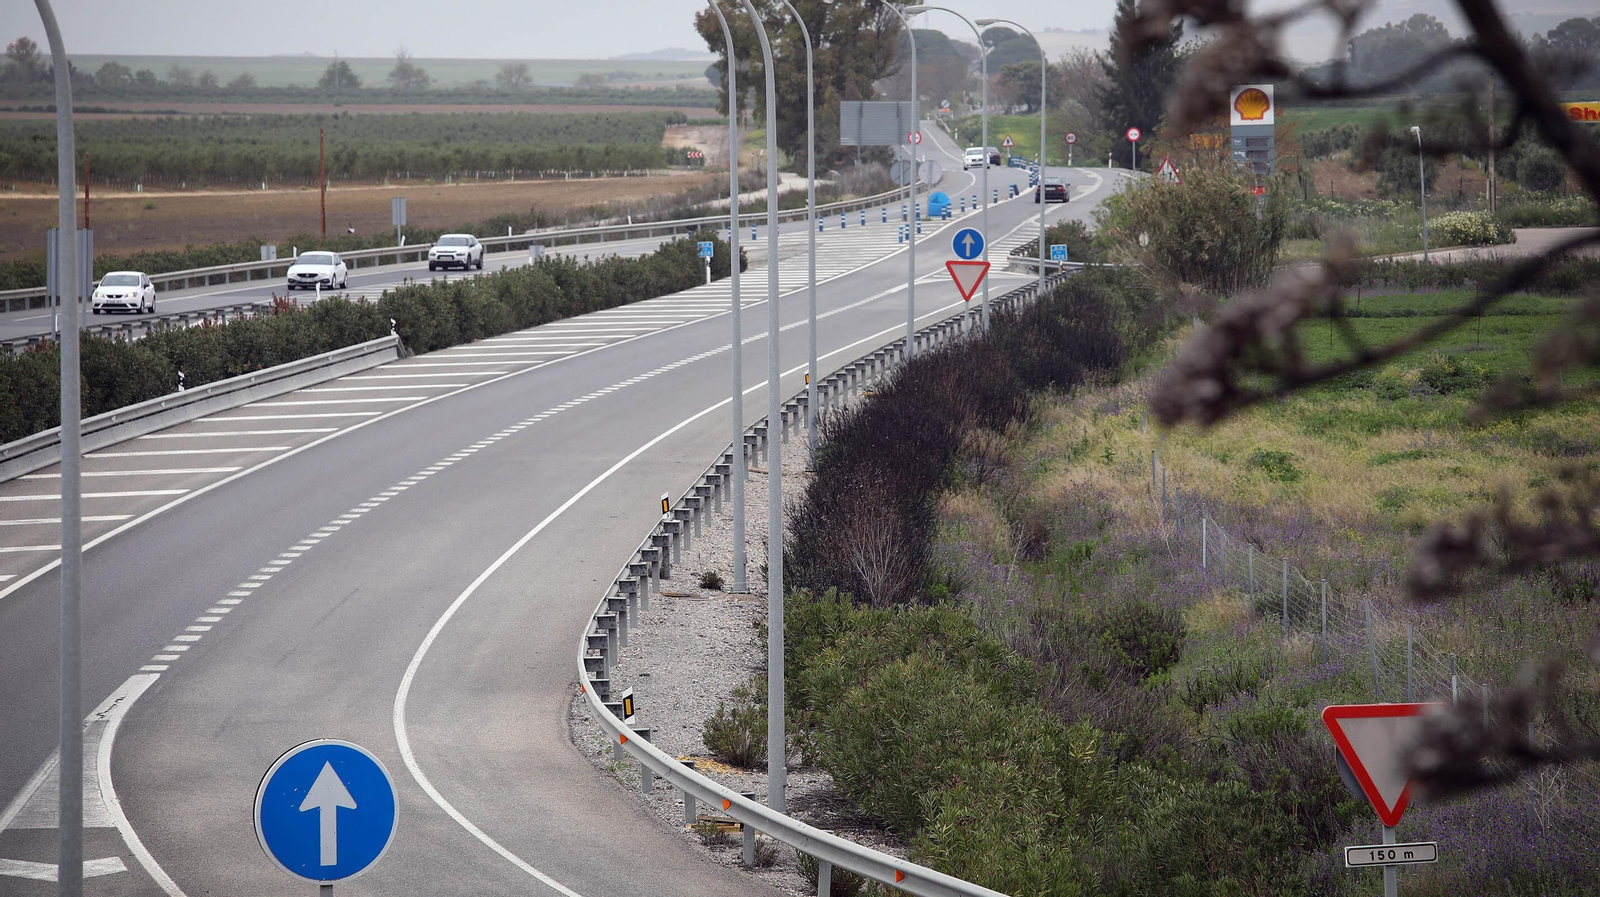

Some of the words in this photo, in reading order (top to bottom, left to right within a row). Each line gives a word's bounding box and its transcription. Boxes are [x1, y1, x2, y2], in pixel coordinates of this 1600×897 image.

[1569, 107, 1600, 120] Sh
[1369, 850, 1396, 861] 150
[1404, 851, 1414, 859] m
